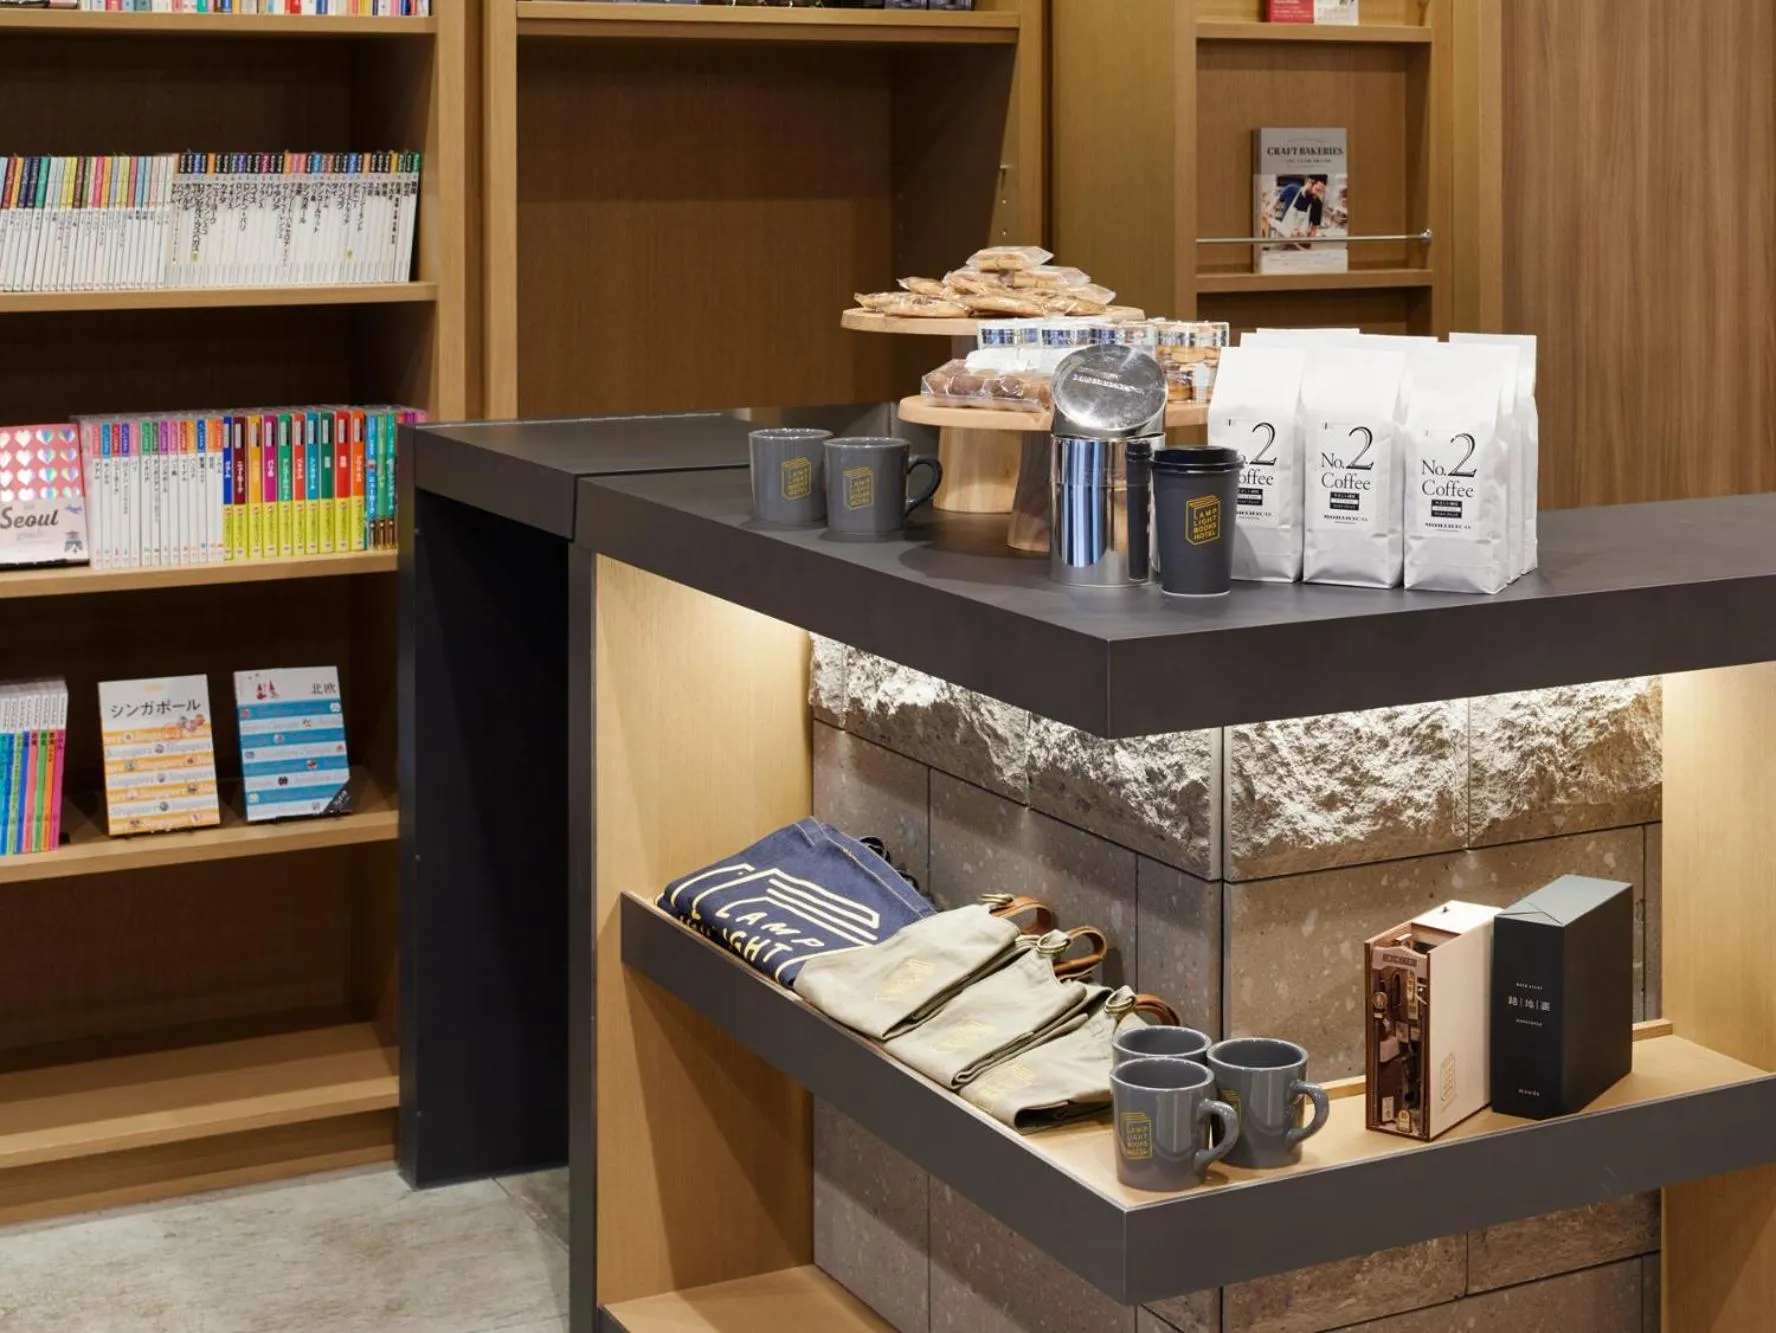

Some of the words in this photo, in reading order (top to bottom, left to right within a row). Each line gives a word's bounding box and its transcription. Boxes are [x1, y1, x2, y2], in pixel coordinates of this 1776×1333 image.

[1267, 146, 1298, 156] CRAFT
[1299, 146, 1344, 156] BAKERIES
[1238, 422, 1277, 466] o.2
[1321, 426, 1374, 470] No.2
[1421, 432, 1477, 478] No.2
[1239, 468, 1274, 486] offee
[1321, 472, 1371, 490] Coffee
[1422, 478, 1475, 498] Coffee
[0, 506, 60, 529] Seoul
[1193, 508, 1217, 519] LAMP
[1193, 515, 1217, 526] LIGHT
[1193, 522, 1217, 534] BOOKS
[1194, 530, 1216, 541] HOTEL
[311, 682, 336, 696] 北欧
[110, 698, 201, 719] シンガポール
[715, 909, 825, 948] LAMP
